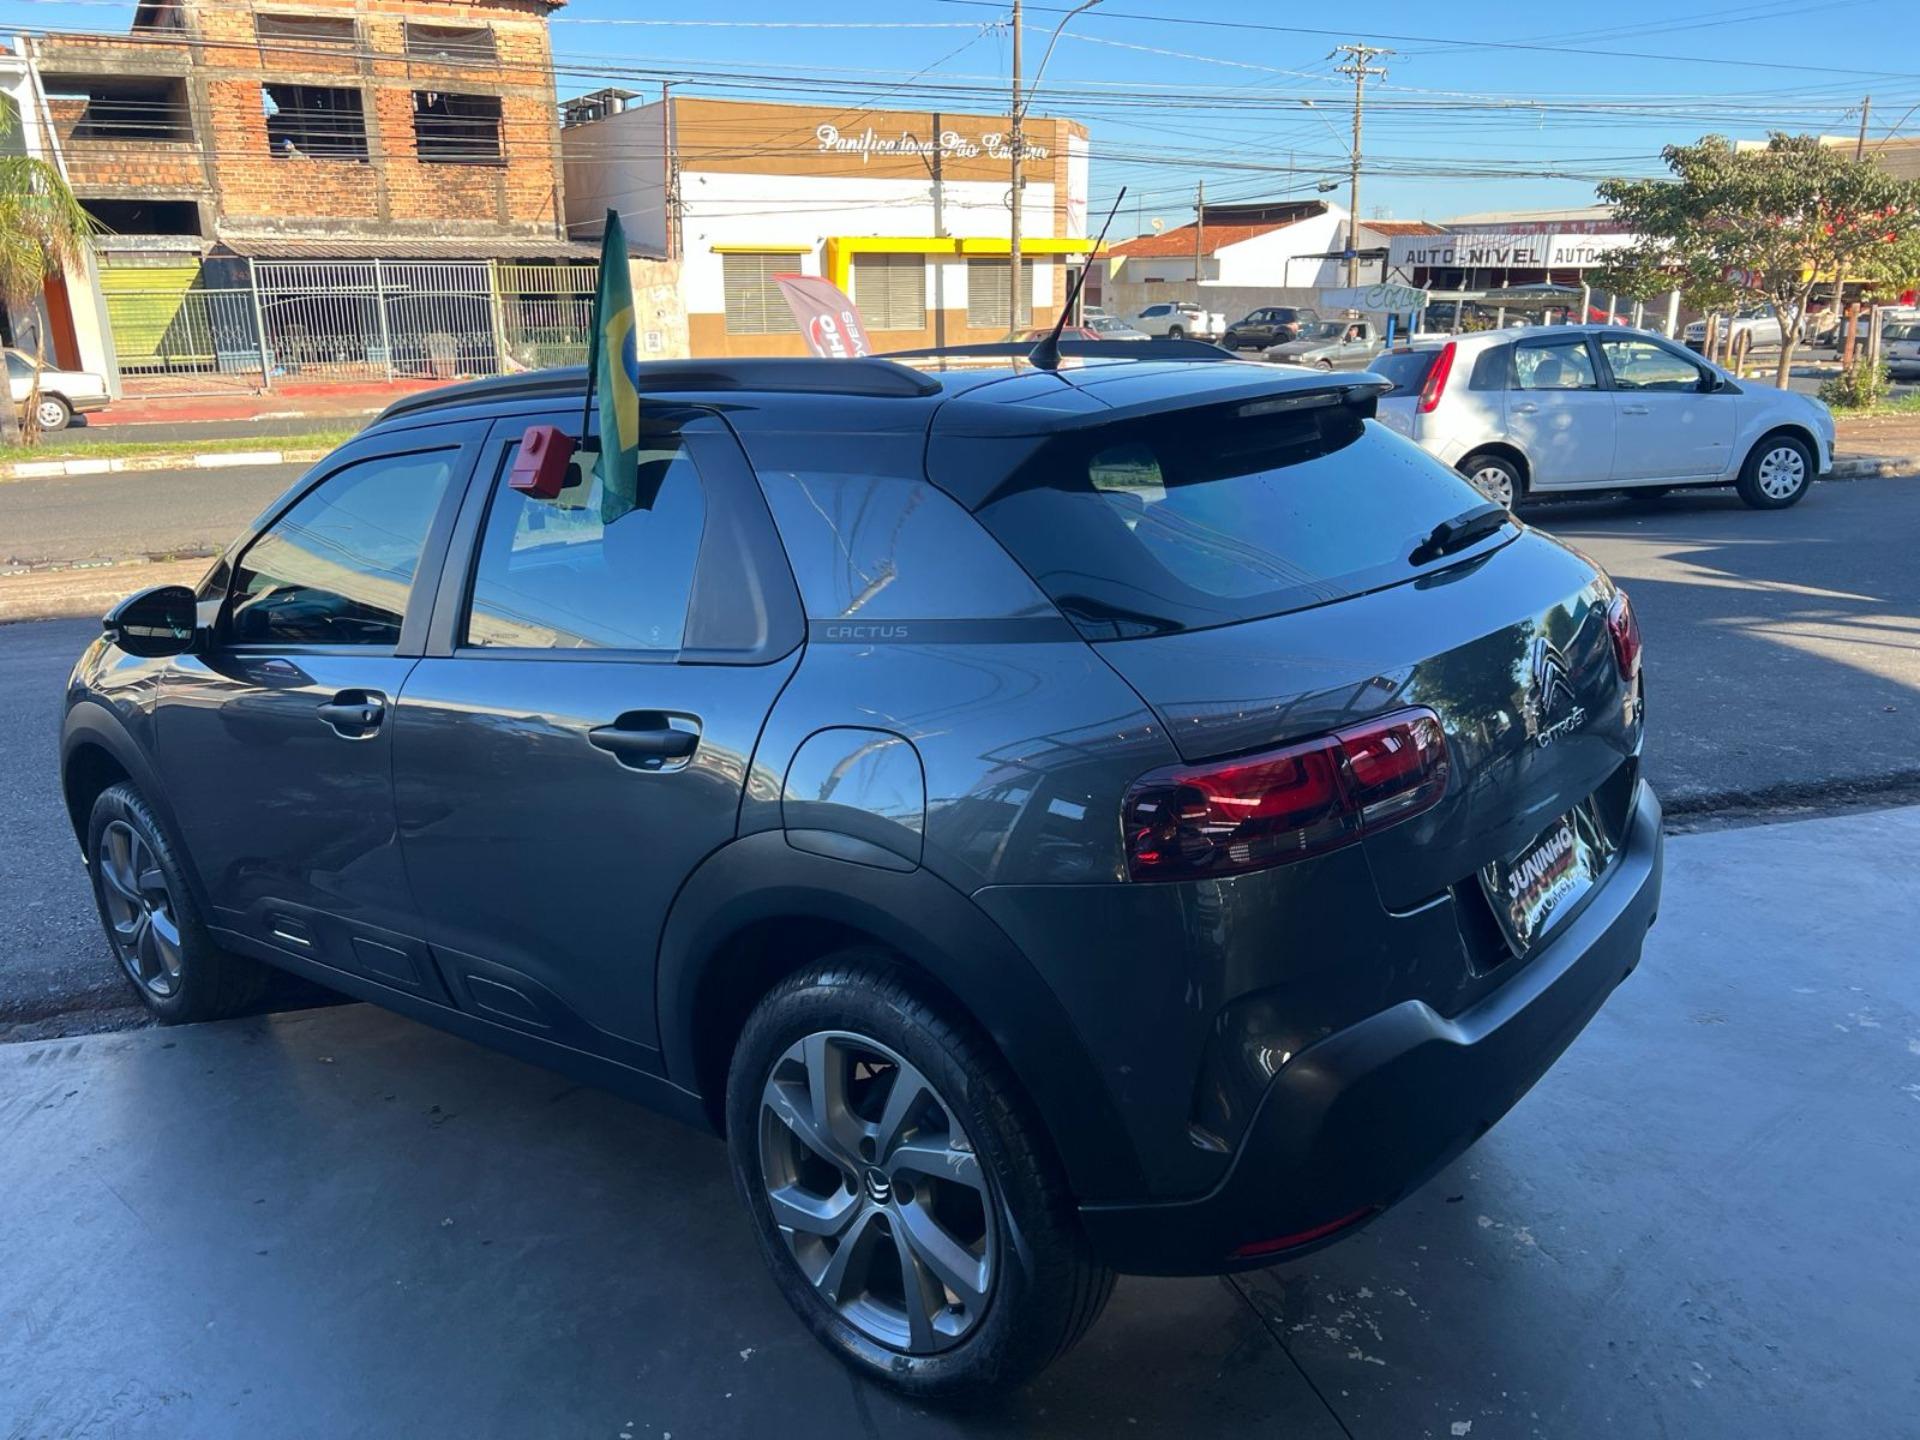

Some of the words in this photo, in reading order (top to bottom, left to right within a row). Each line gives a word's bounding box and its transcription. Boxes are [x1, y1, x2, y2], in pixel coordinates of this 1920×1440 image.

[816, 124, 935, 164] Panificadora
[939, 131, 979, 158] Pão
[826, 626, 909, 638] CACTUS
[1508, 827, 1573, 898] JUNINHO
